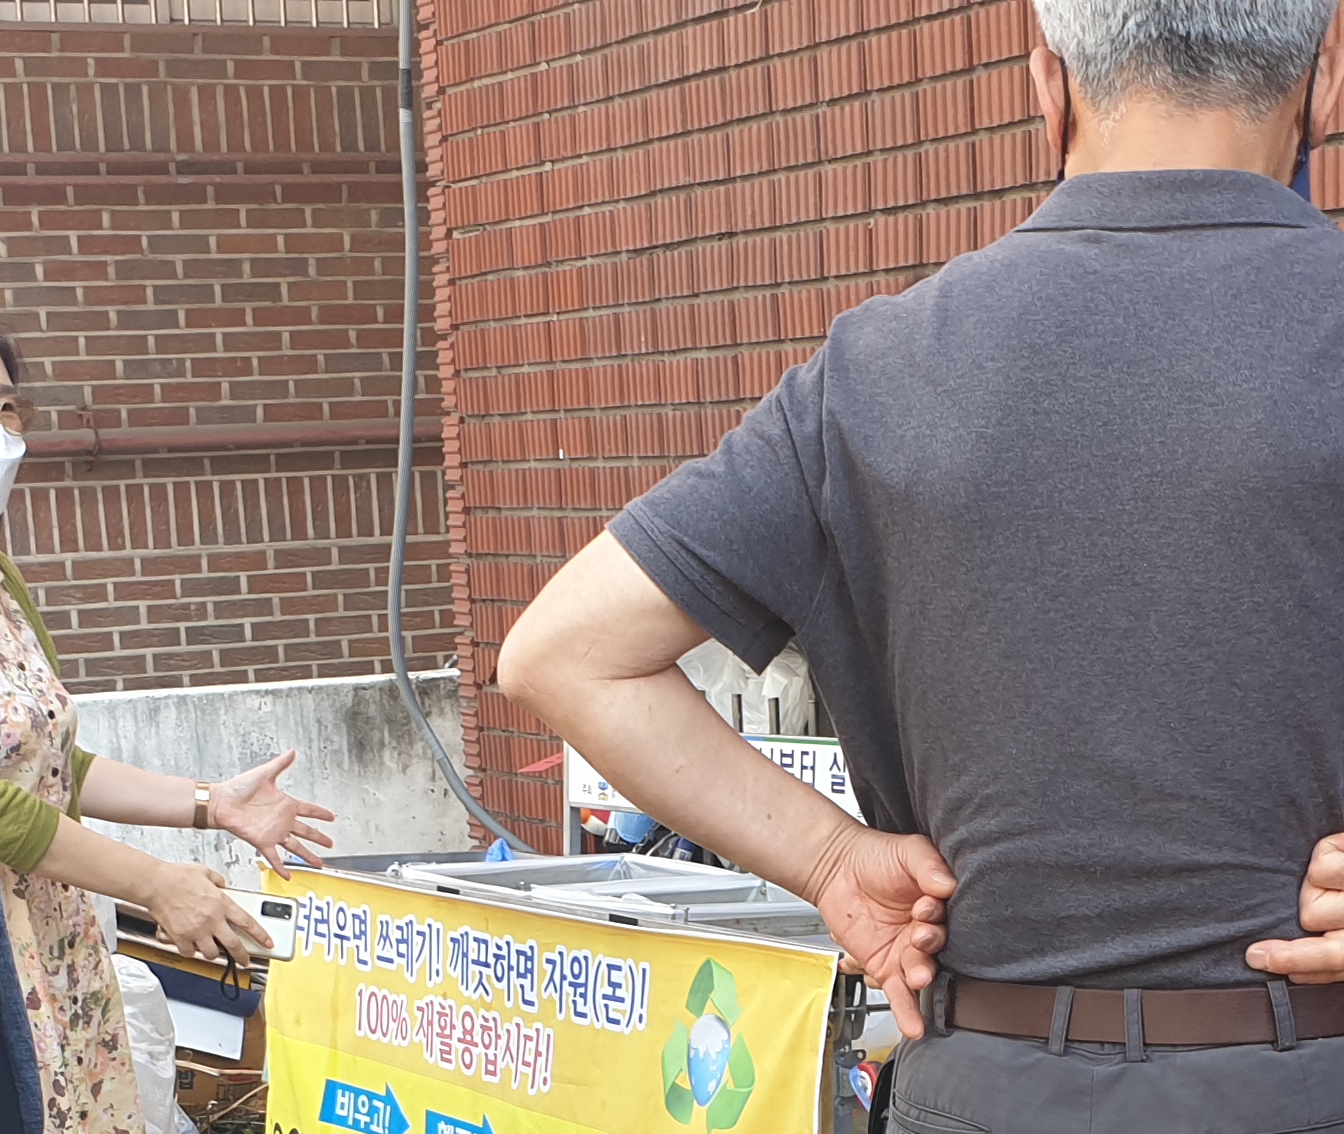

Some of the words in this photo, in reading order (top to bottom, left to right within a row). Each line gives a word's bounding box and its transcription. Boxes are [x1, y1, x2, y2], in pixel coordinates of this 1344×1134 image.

[760, 748, 816, 788] 부터
[376, 919, 442, 982] 쓰레기!
[449, 931, 536, 1008] 깨끗하면
[543, 950, 648, 1029] 자원(돈)!
[357, 988, 408, 1041] 100%
[415, 999, 552, 1090] 재활용합시다!
[335, 1088, 392, 1134] 비우고!
